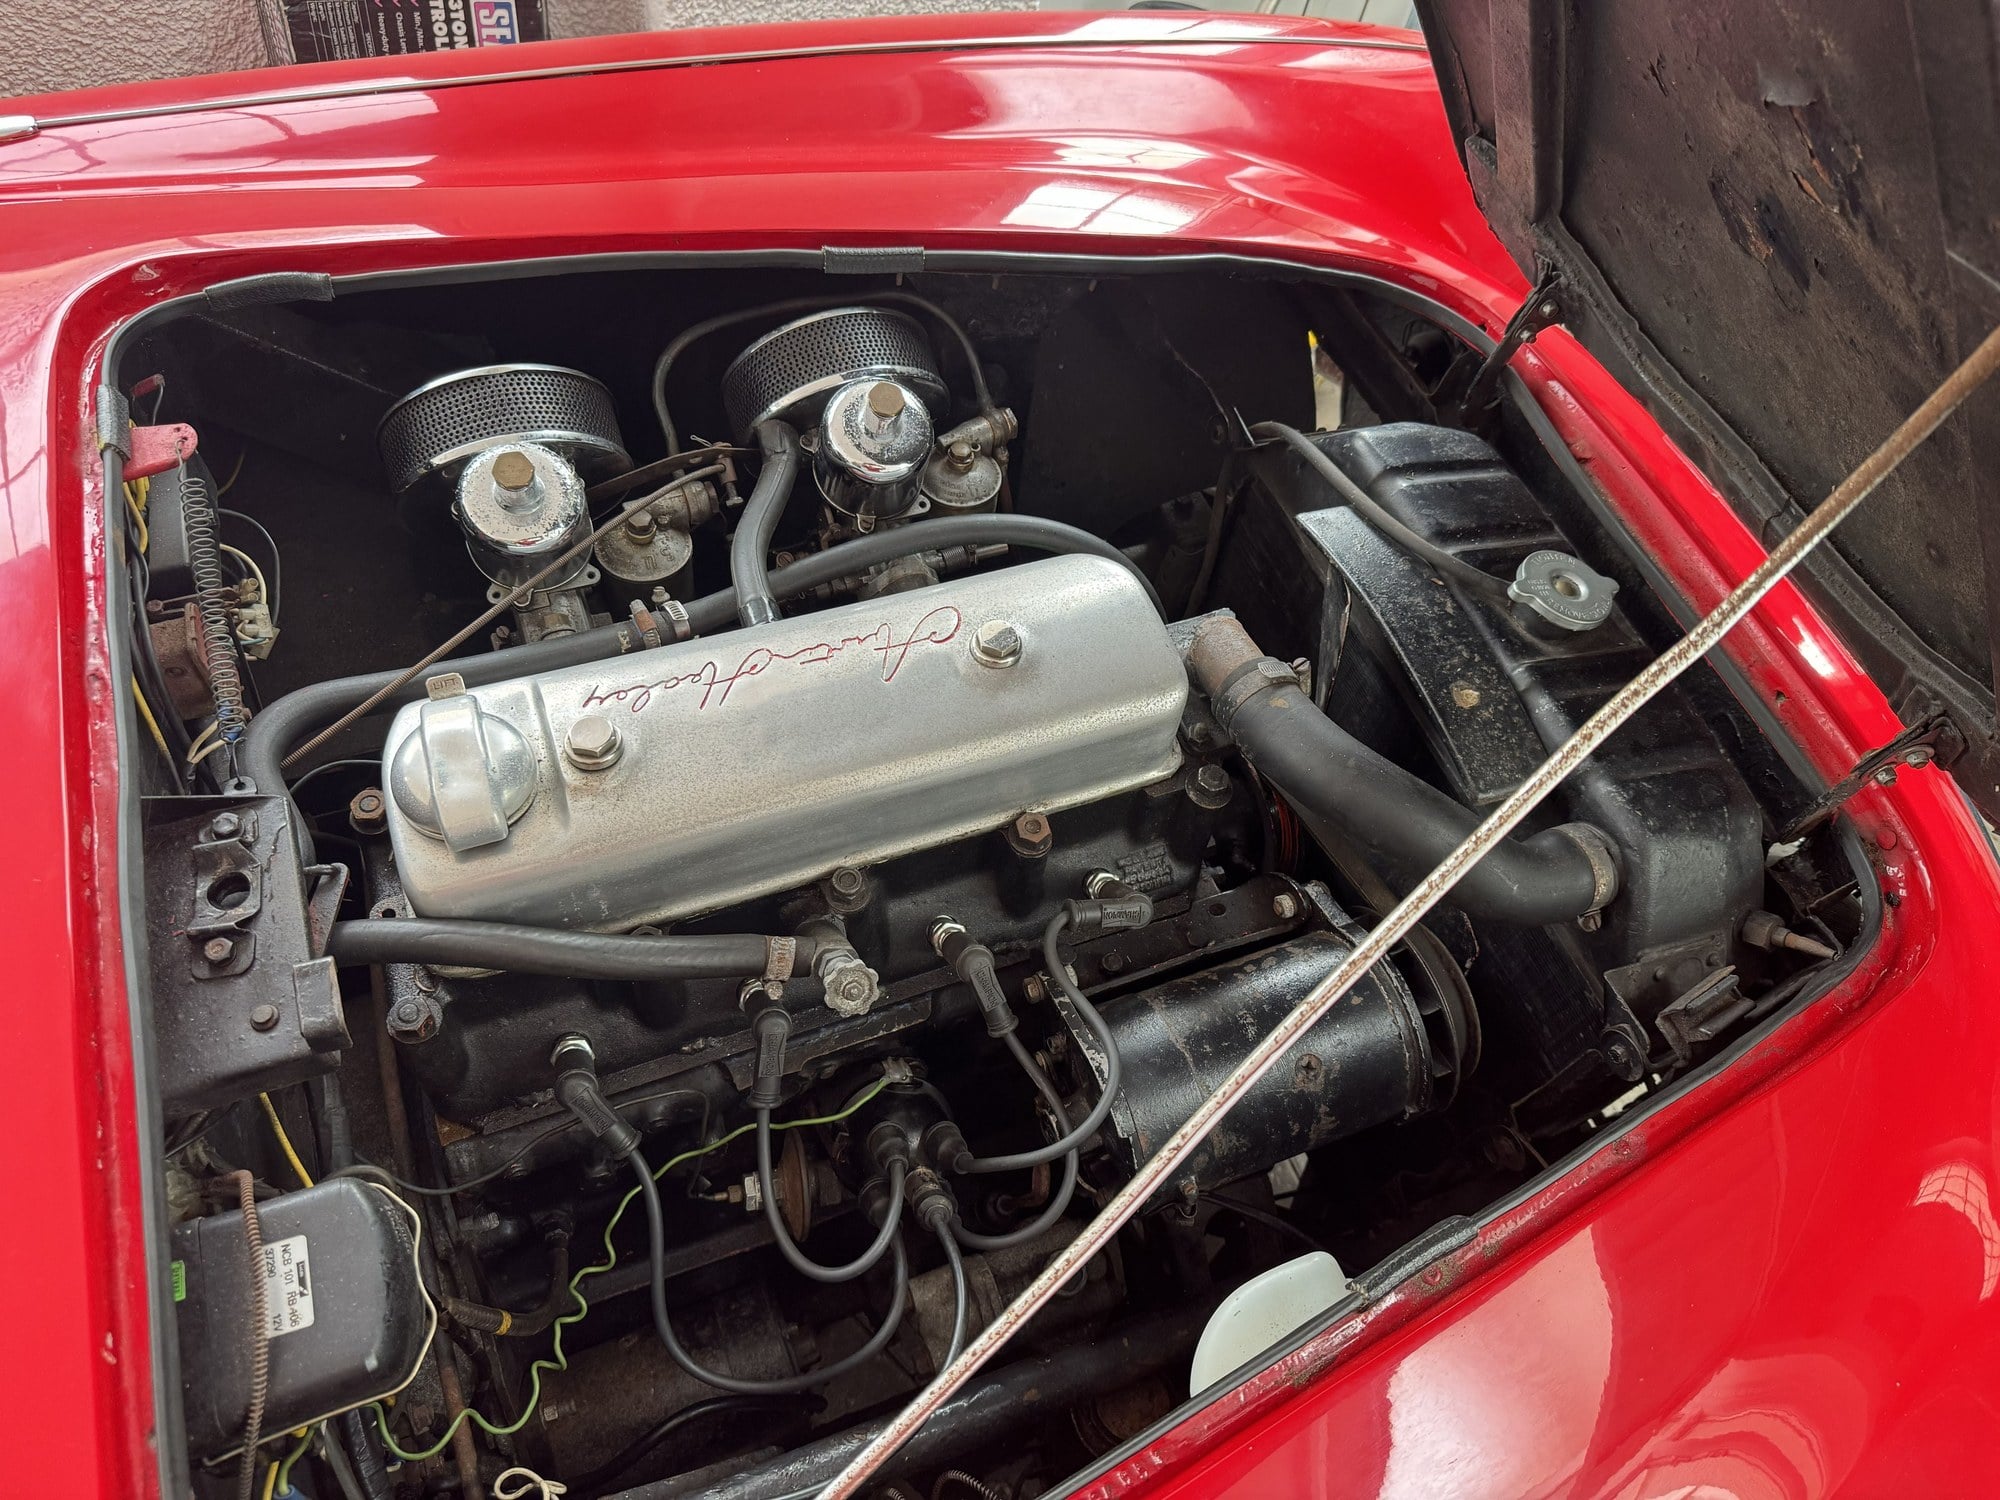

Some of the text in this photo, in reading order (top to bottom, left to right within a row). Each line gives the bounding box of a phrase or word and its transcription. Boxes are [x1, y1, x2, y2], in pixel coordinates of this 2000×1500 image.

[396, 12, 404, 37] Chassis
[433, 678, 457, 690] LIFT
[280, 1243, 293, 1266] NCB
[284, 1269, 294, 1286] 101
[286, 1290, 297, 1306] RB
[273, 1313, 283, 1332] 12V
